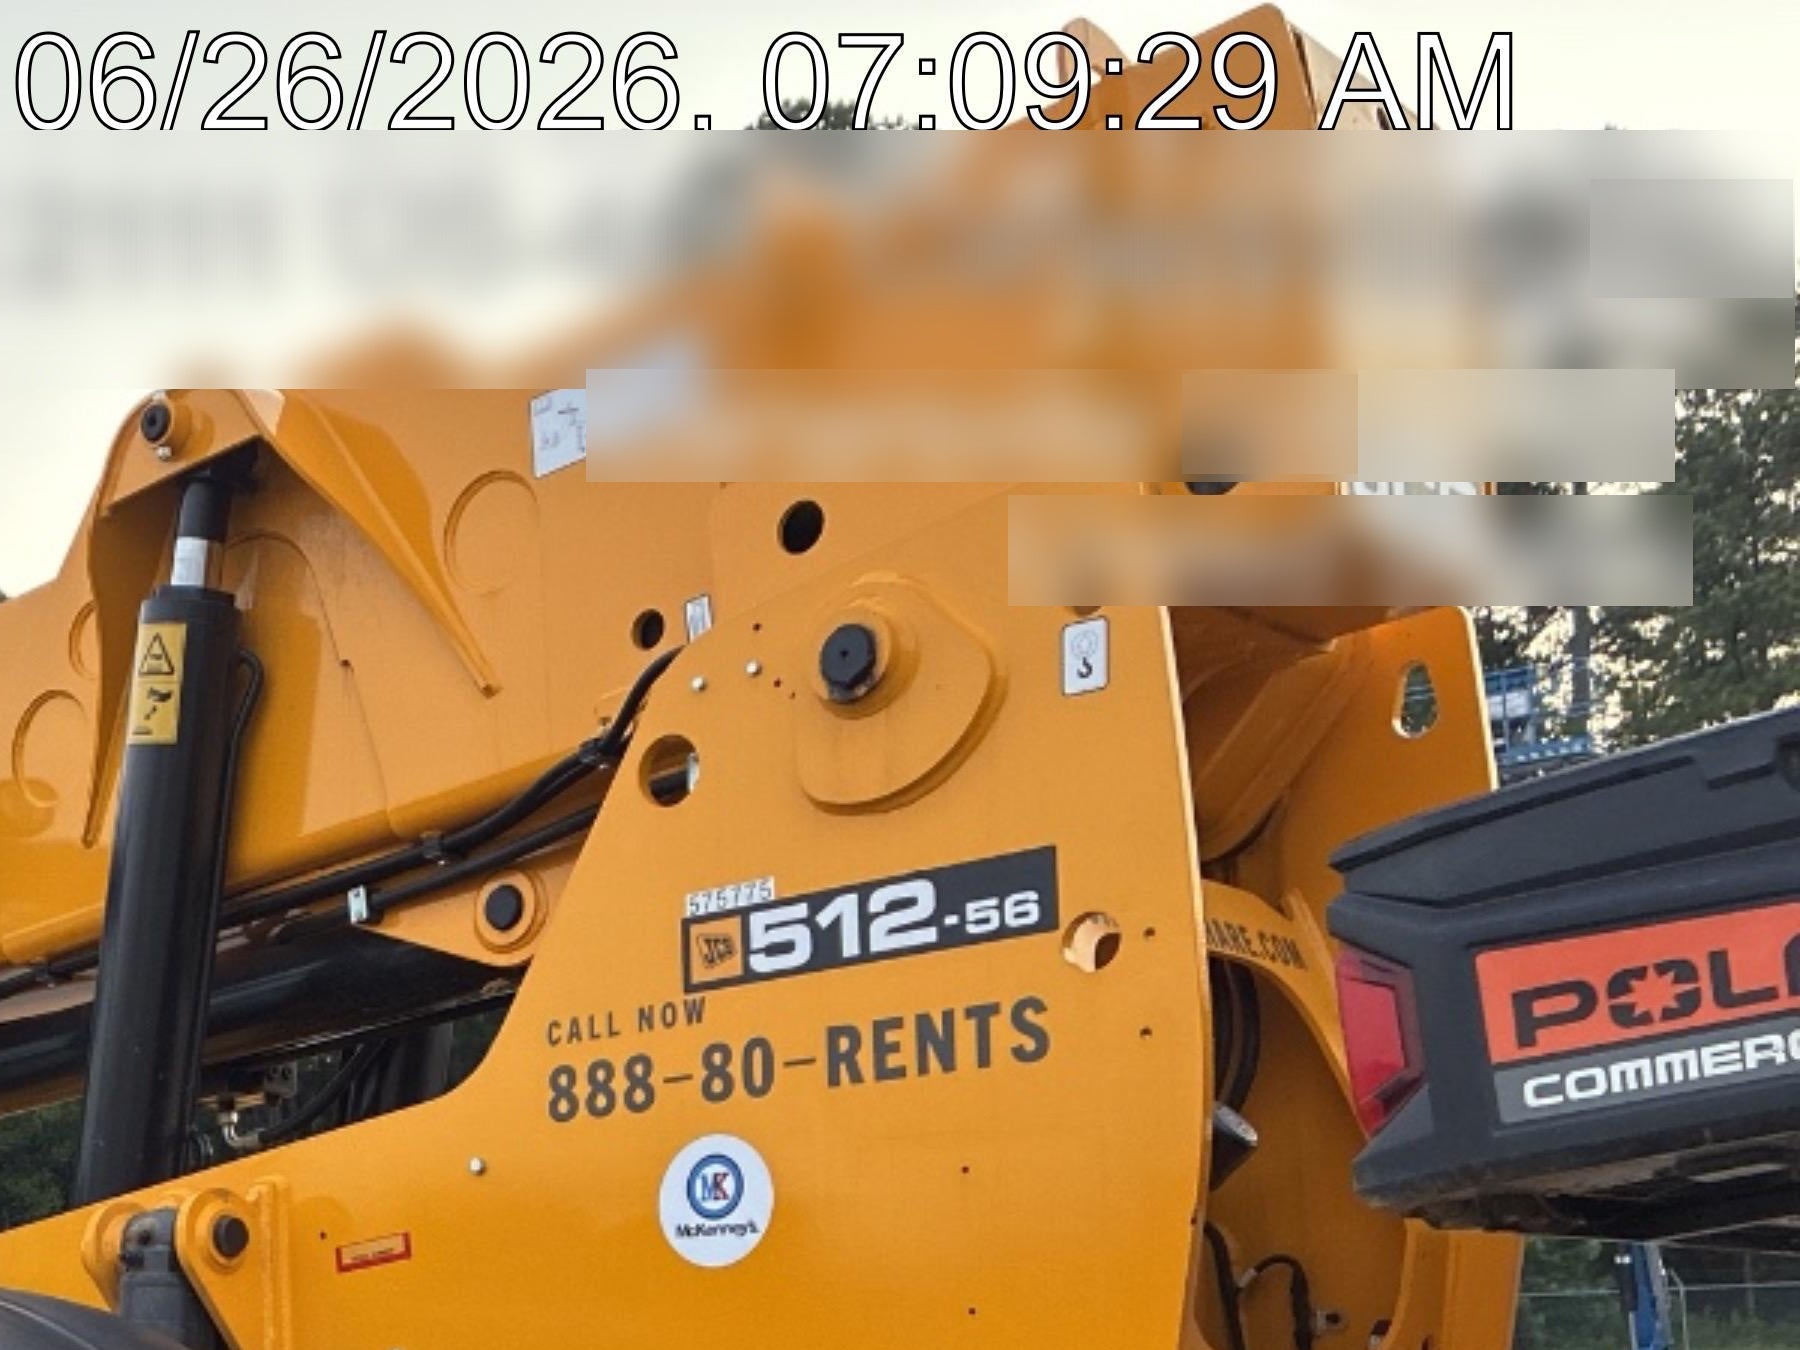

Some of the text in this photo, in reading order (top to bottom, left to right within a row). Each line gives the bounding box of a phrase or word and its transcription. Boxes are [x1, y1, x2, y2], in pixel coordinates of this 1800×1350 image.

[547, 996, 706, 1046] CALL NOW
[1511, 933, 1800, 1050] POL
